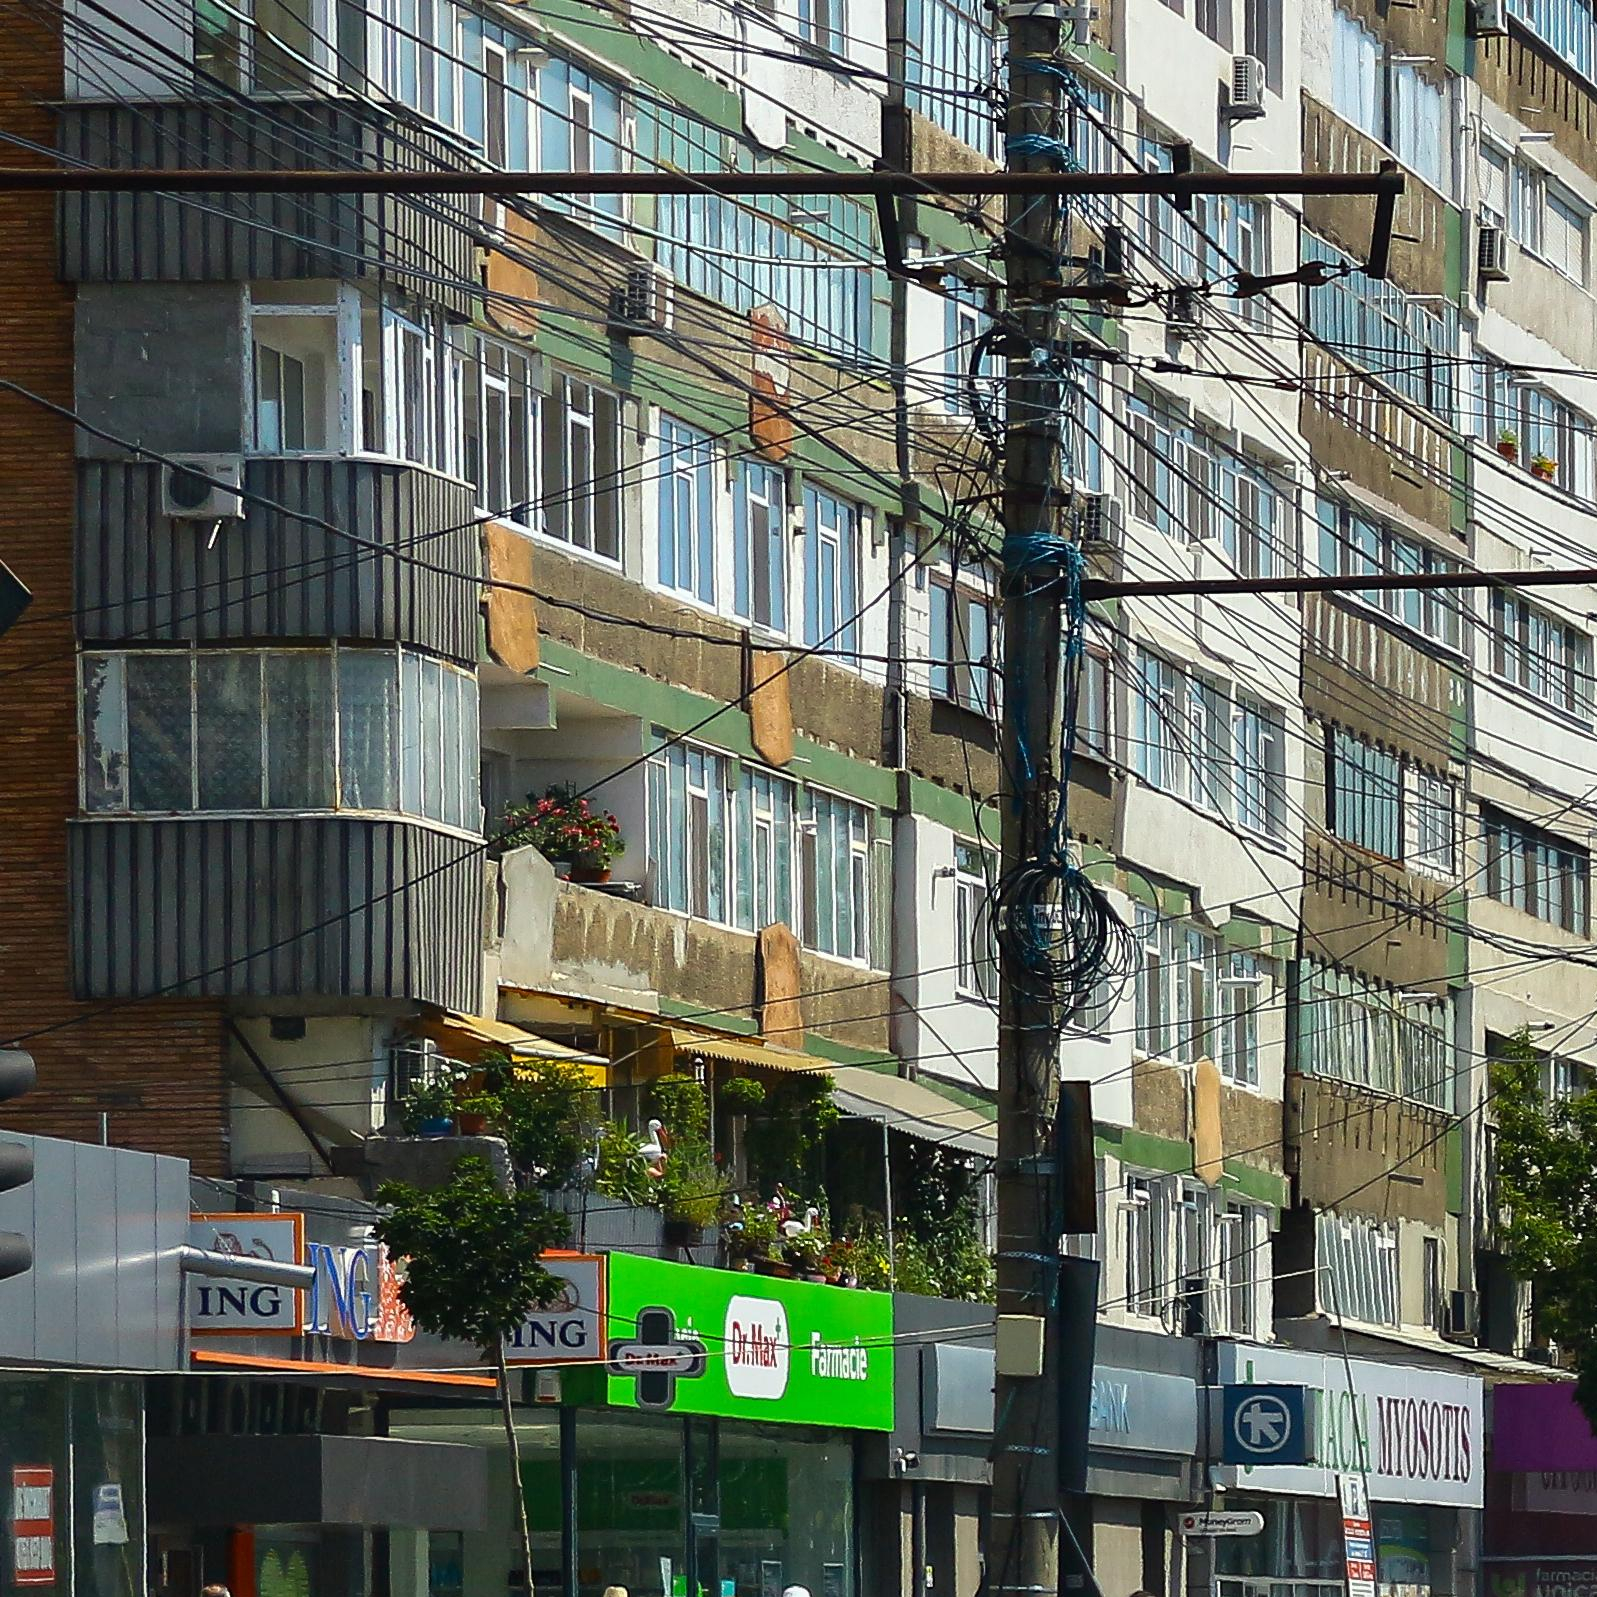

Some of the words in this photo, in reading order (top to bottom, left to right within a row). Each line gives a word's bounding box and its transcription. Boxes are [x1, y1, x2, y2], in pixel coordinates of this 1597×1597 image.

[197, 1286, 282, 1316] ING
[309, 1242, 372, 1340] ING
[511, 1319, 588, 1347] ING
[732, 1320, 777, 1368] Dr.Max
[811, 1331, 868, 1380] Farmacie
[1377, 1396, 1471, 1483] MYOSOTIS
